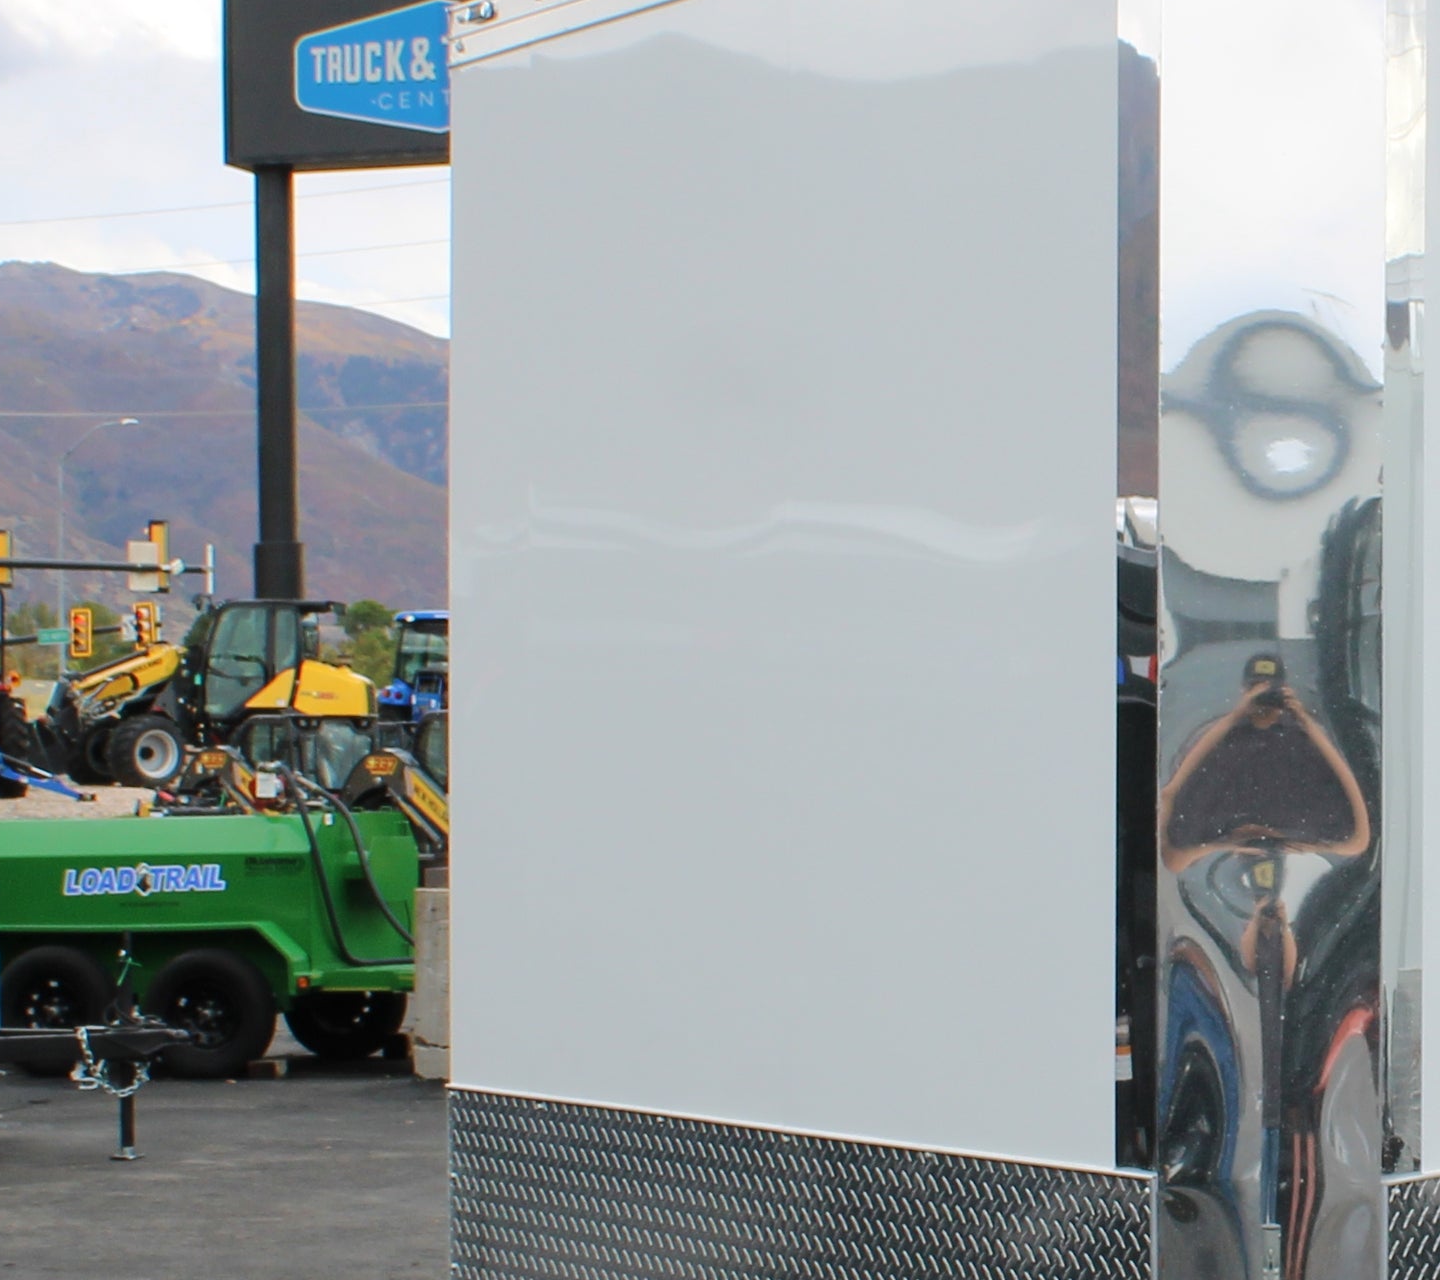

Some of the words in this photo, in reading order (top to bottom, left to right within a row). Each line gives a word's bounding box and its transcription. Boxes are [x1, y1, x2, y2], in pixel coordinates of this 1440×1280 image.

[310, 39, 406, 84] TRUCK
[410, 36, 436, 81] &
[63, 867, 137, 896] LOAD
[148, 863, 226, 892] TRAIL
